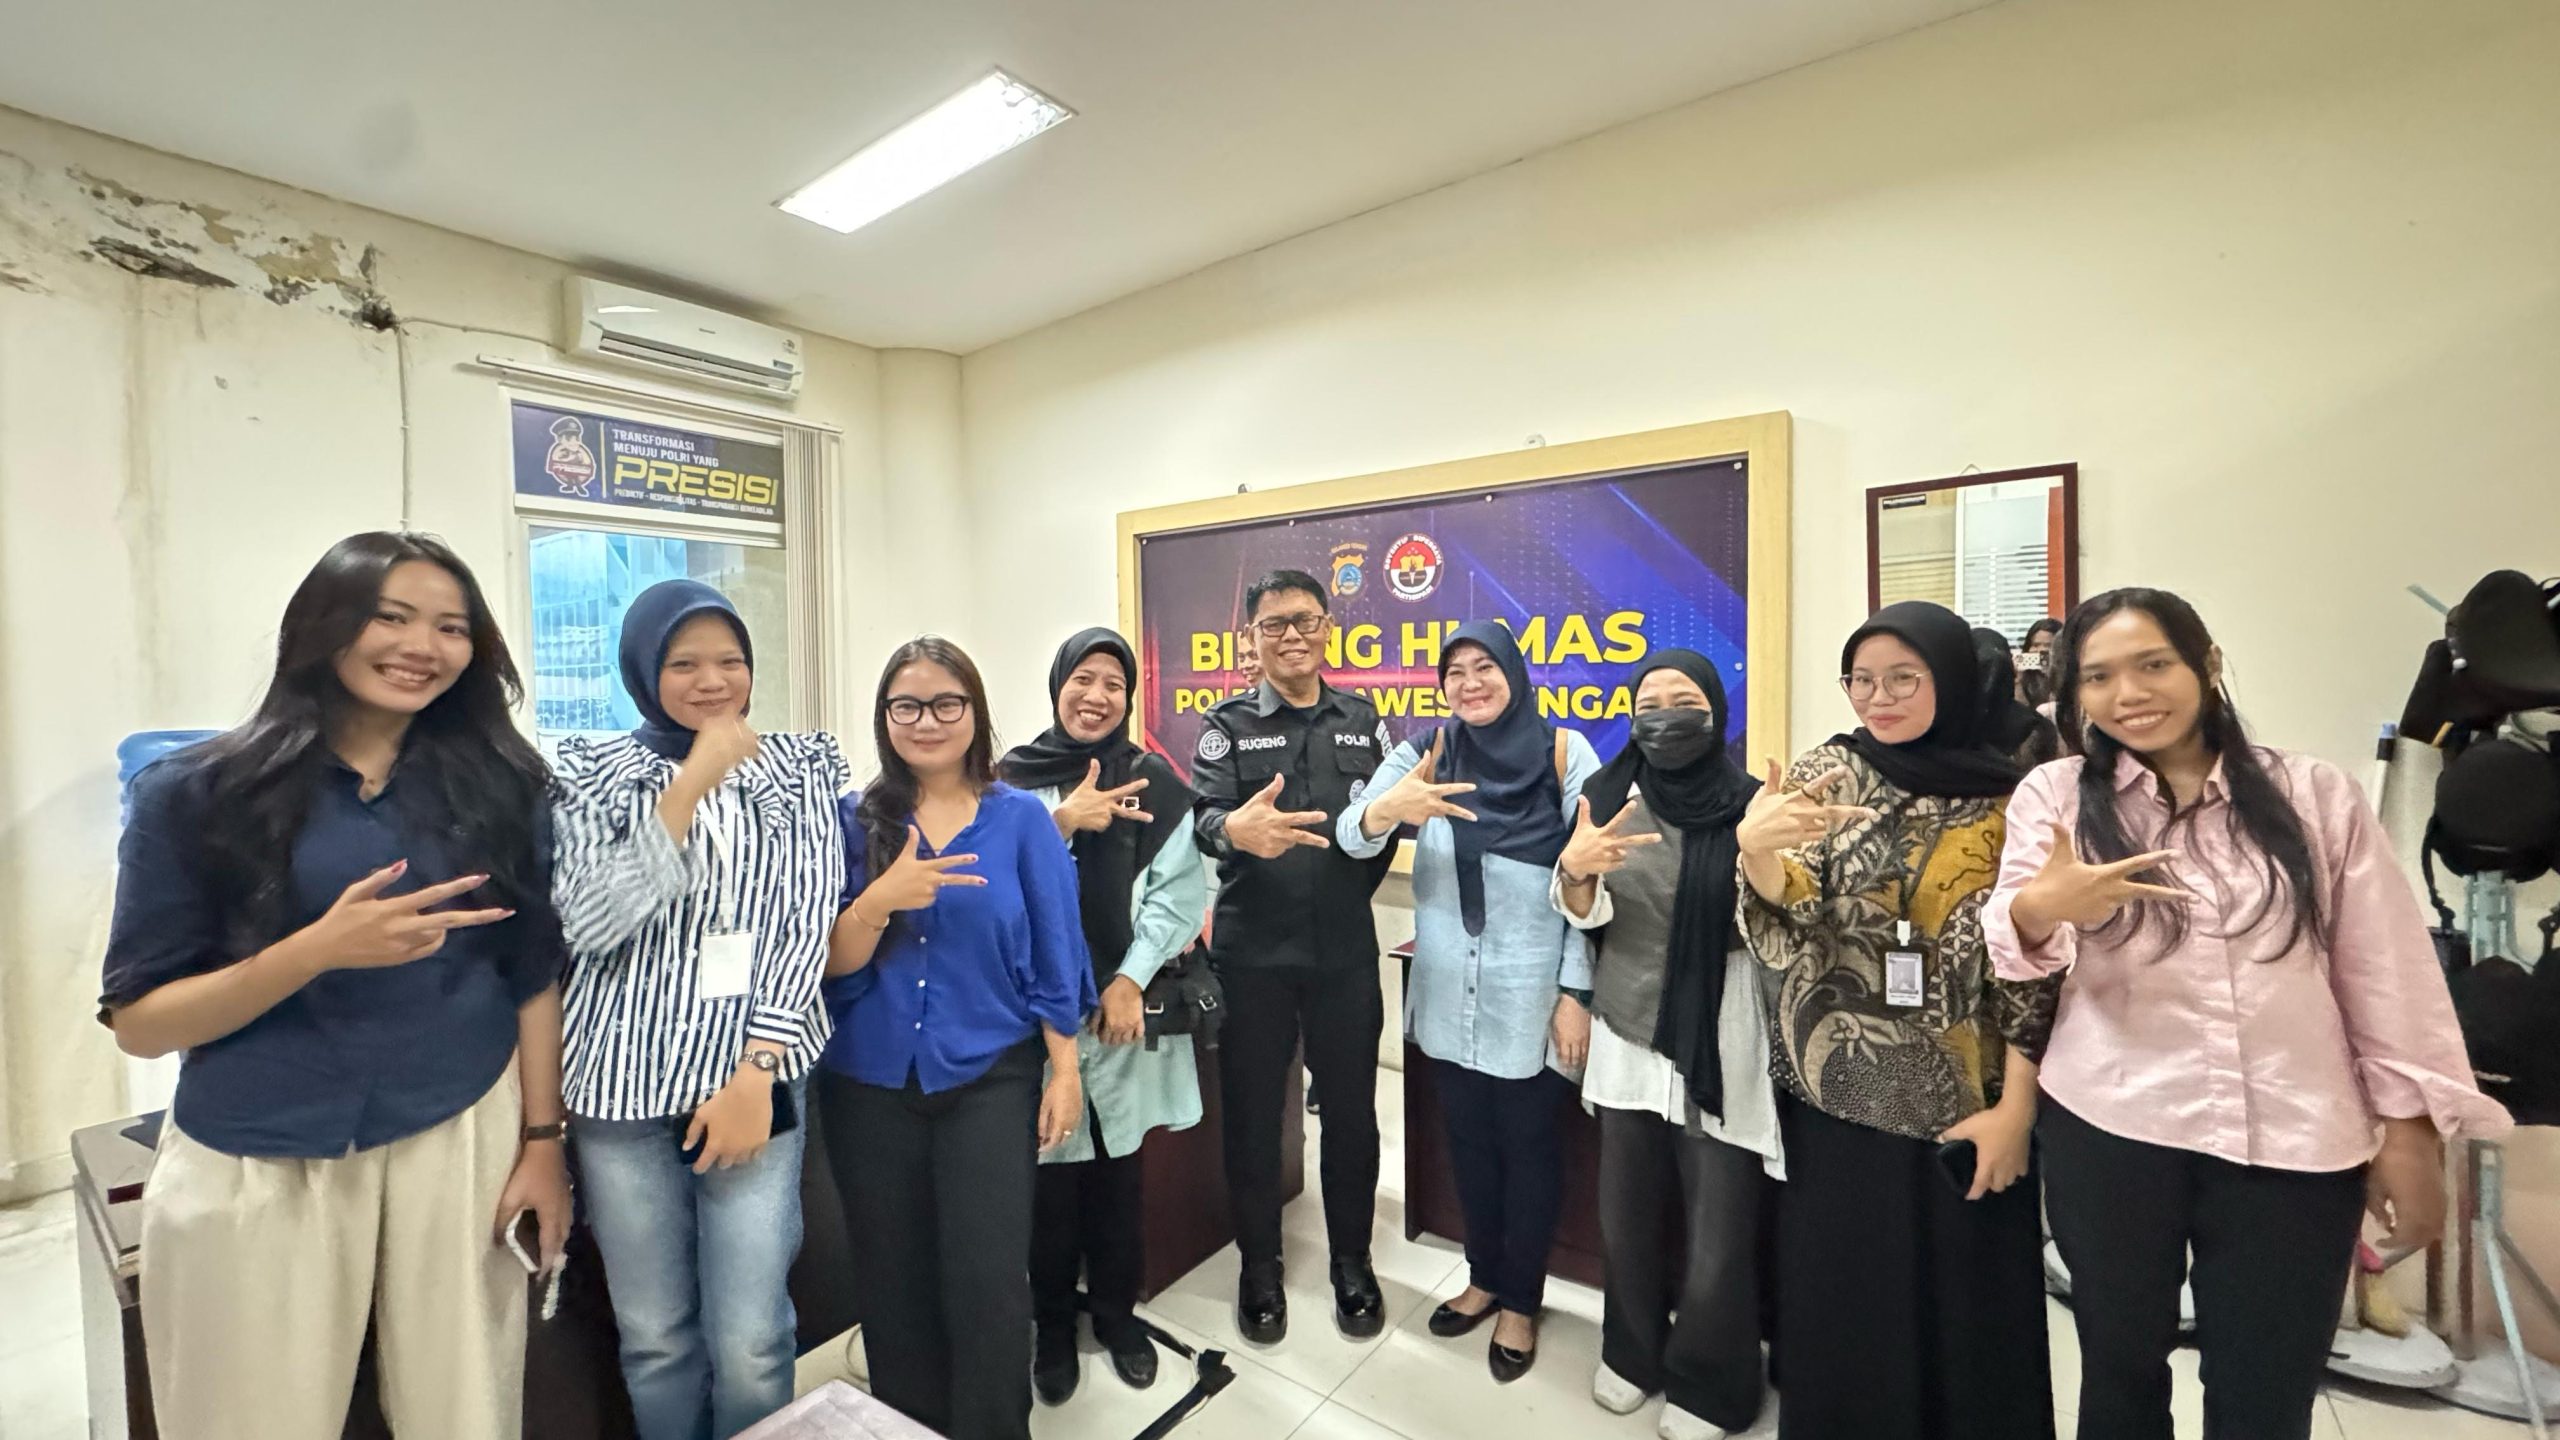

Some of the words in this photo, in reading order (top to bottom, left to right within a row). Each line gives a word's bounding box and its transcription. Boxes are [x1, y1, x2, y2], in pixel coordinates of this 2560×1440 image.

[612, 429, 695, 451] TRANSFORMASI
[613, 442, 658, 458] MENUJU
[660, 450, 691, 463] POLRI
[693, 456, 720, 468] YANG
[614, 455, 779, 506] PRESISI
[1192, 624, 1383, 672] BING
[1402, 611, 1648, 668] HMAS
[1238, 735, 1287, 751] SUGENG
[1335, 734, 1370, 748] POLRI
